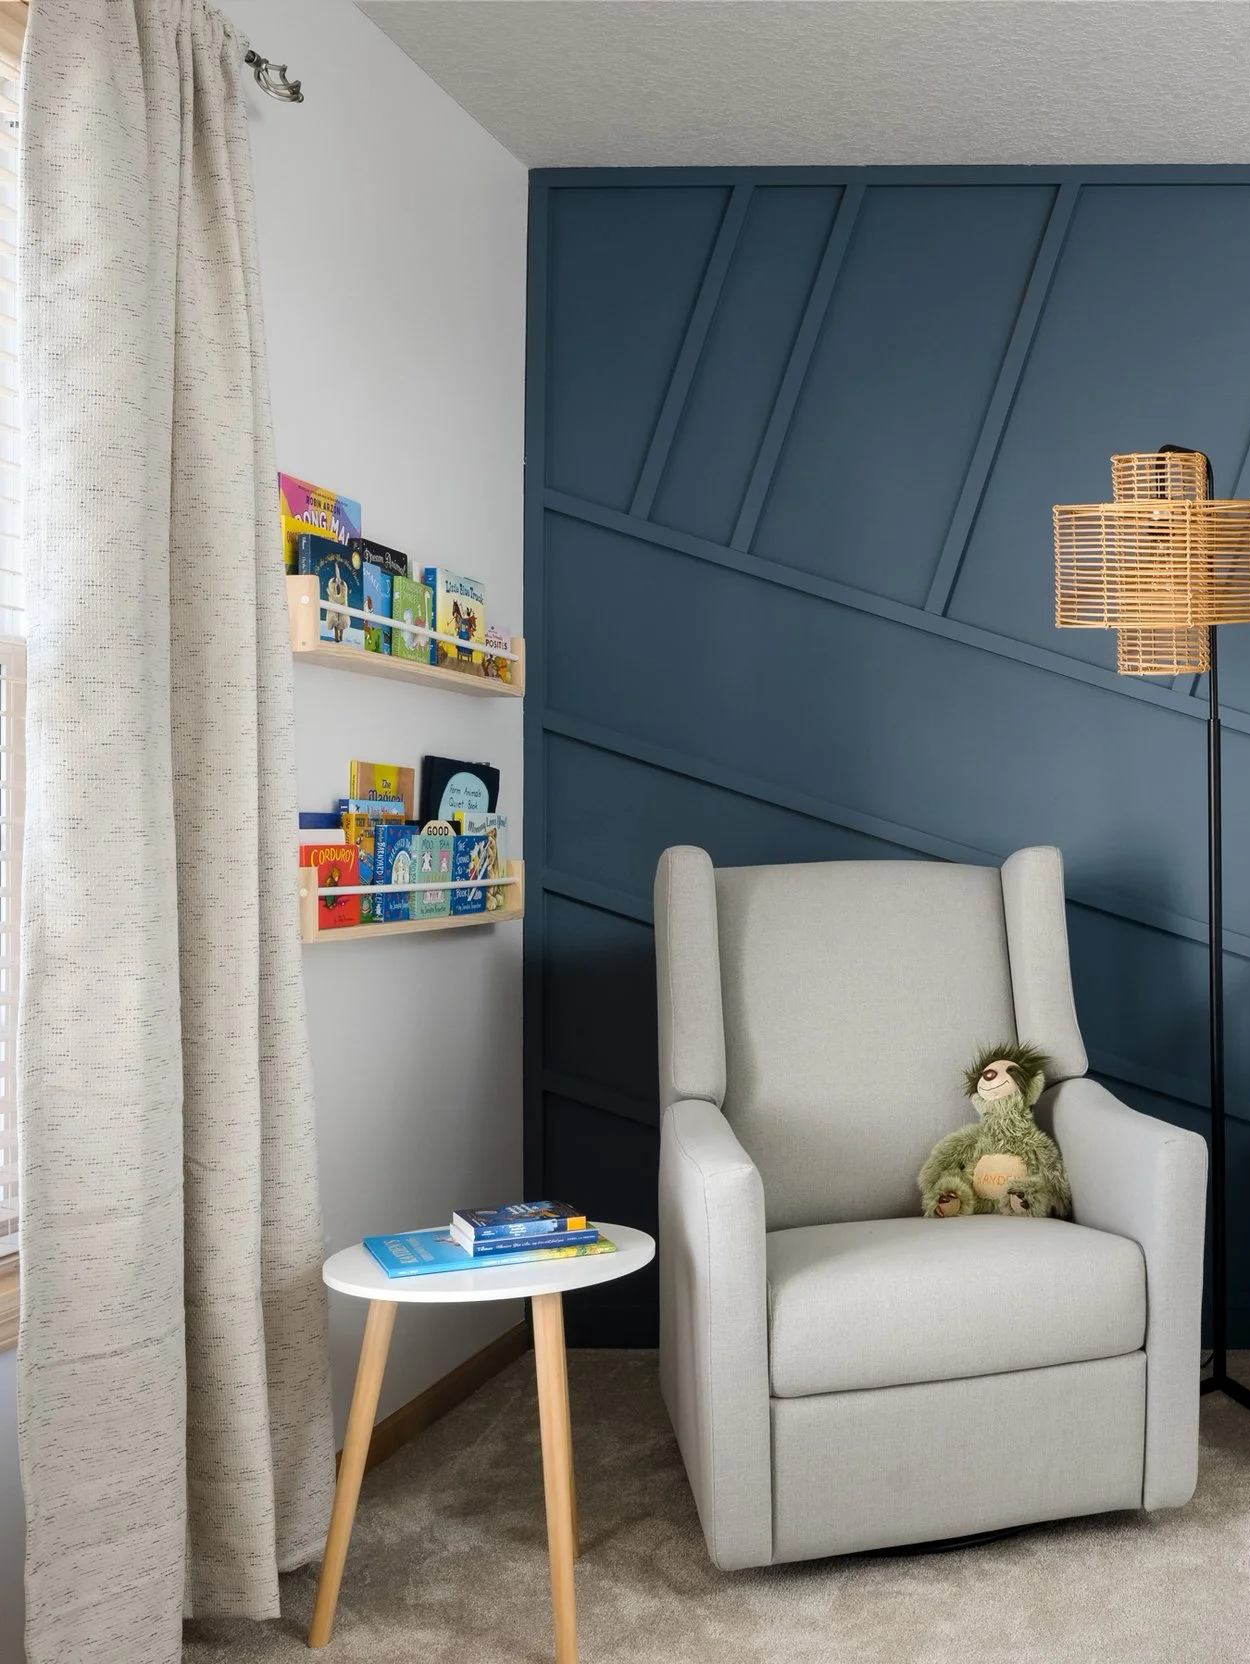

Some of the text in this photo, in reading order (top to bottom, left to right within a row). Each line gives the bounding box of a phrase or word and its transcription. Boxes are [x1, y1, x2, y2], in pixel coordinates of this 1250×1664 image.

[306, 495, 321, 507] ROBIN
[363, 548, 384, 565] Dream
[445, 579, 484, 605] Little Blue Truck
[382, 779, 392, 789] The
[448, 797, 478, 810] Quiet Book
[427, 826, 449, 836] GOOD
[457, 840, 467, 851] THE
[311, 848, 355, 873] CORDUROY
[376, 842, 385, 876] BARNYARD
[976, 1175, 1023, 1186] KAYD
